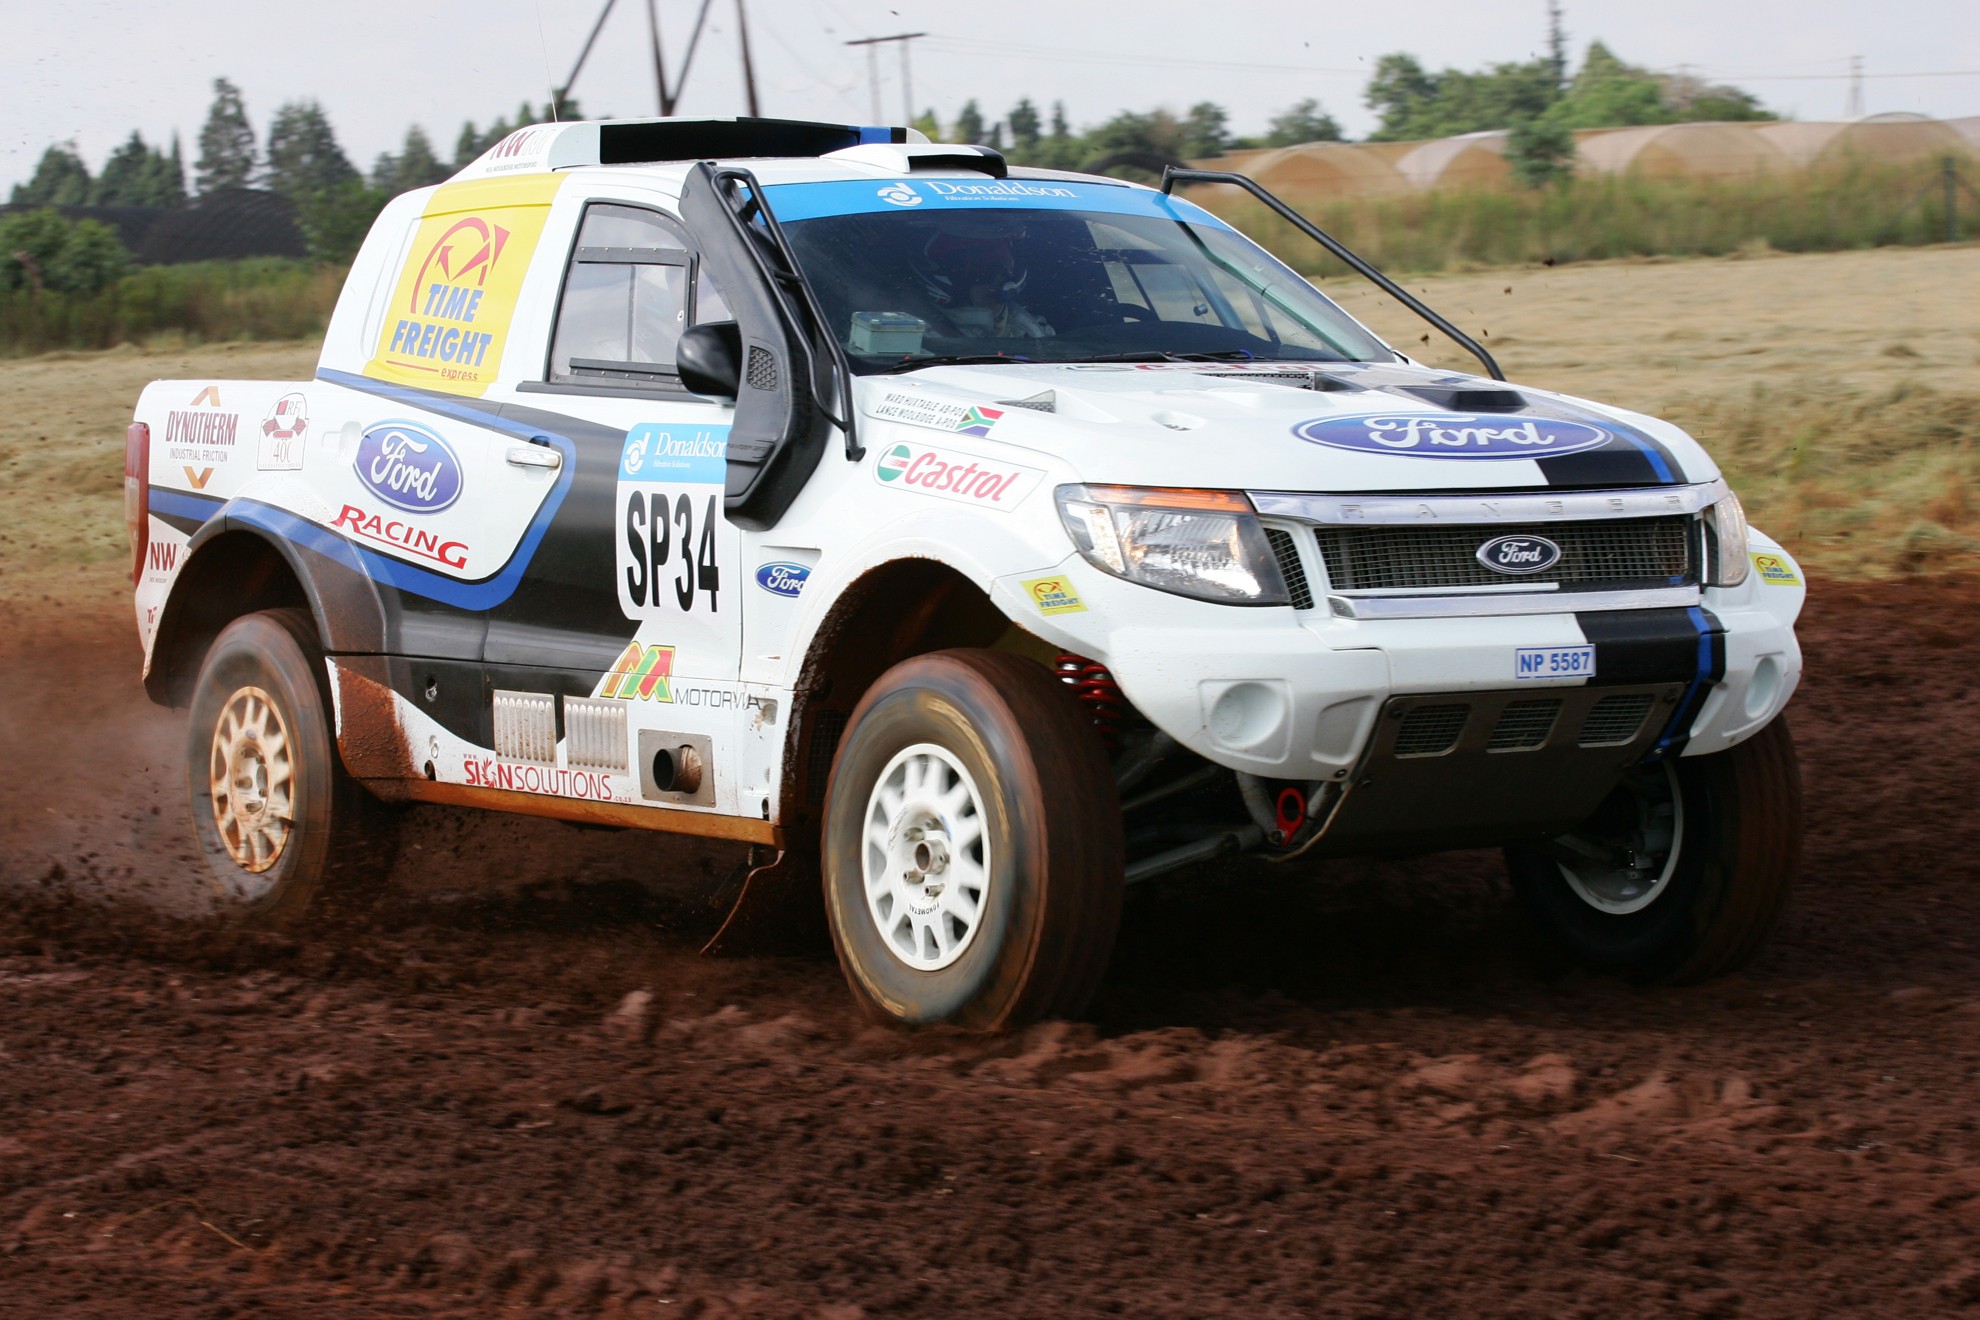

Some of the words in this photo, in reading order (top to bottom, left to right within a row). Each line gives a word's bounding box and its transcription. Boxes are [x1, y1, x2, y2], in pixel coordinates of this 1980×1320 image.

[923, 182, 1077, 198] Donaldson
[423, 284, 484, 322] TIME
[389, 320, 493, 367] FREIGHT
[441, 367, 478, 380] express
[875, 404, 899, 417] LANCE
[165, 410, 239, 446] DYNOTHERM
[1363, 417, 1555, 448] Ford
[170, 448, 200, 460] INDUSTRIAL
[202, 450, 228, 462] FRICTION
[371, 431, 443, 501] Ford
[904, 452, 1021, 501] Castrol
[1340, 495, 1681, 519] RANGER
[328, 504, 469, 569] RACING
[626, 490, 720, 612] SP34
[1499, 541, 1542, 564] Ford
[1520, 654, 1544, 672] NP
[1550, 652, 1590, 671] 5587
